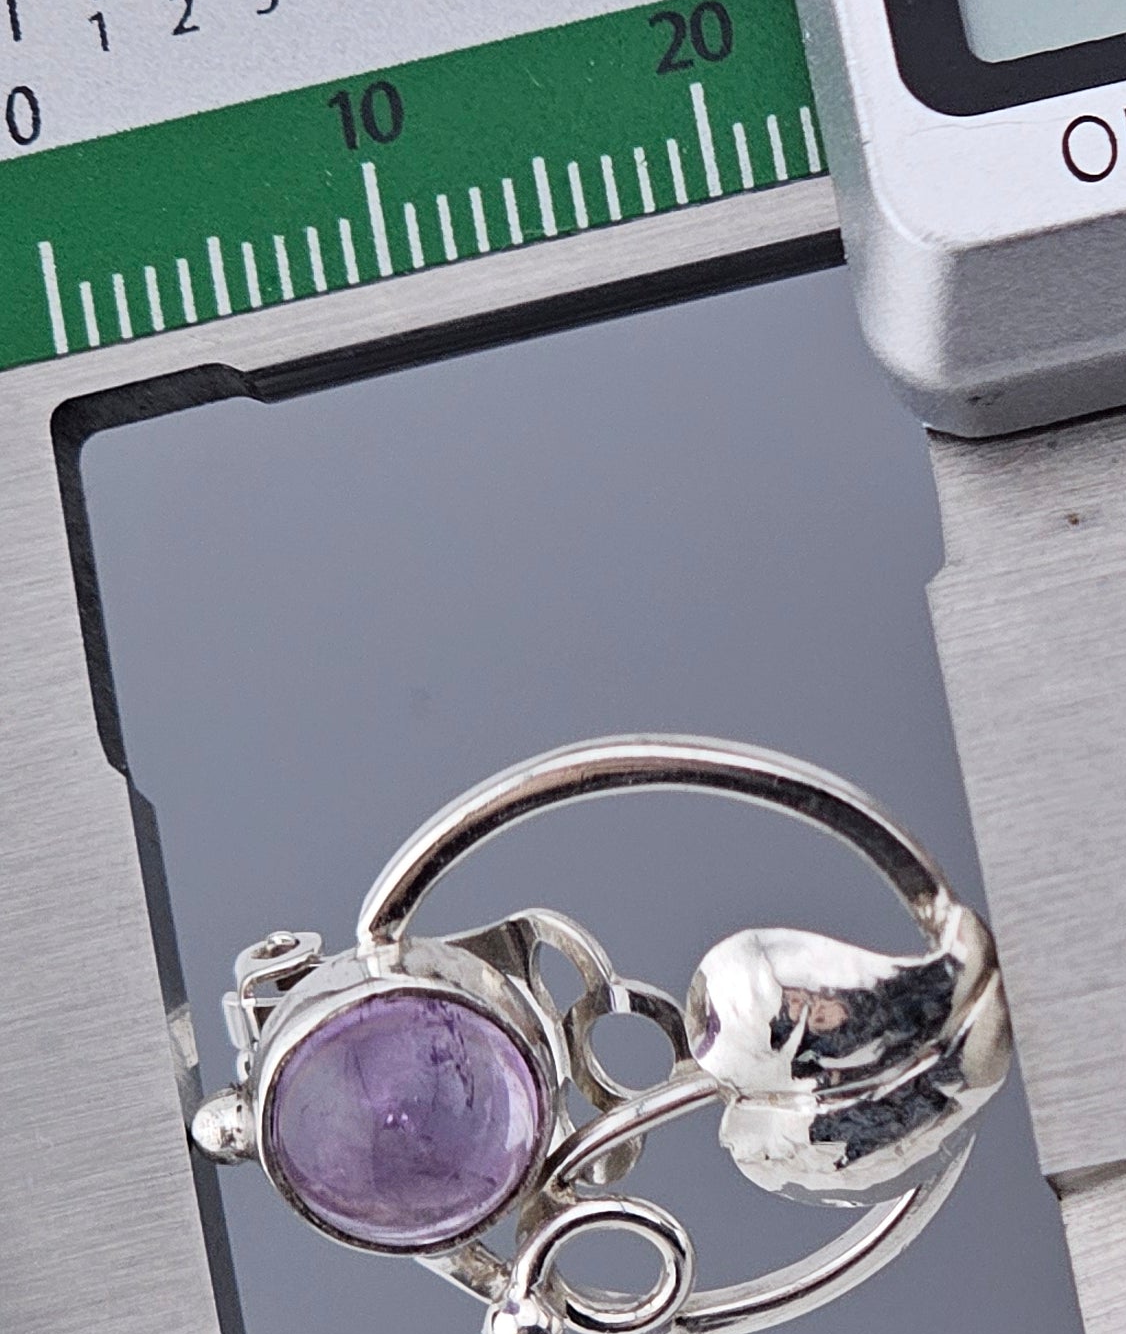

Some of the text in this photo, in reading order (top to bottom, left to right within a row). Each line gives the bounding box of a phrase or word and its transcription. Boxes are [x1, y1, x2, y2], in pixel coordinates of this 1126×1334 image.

[5, 0, 734, 151] 0 10 20
[89, 12, 109, 51] 1
